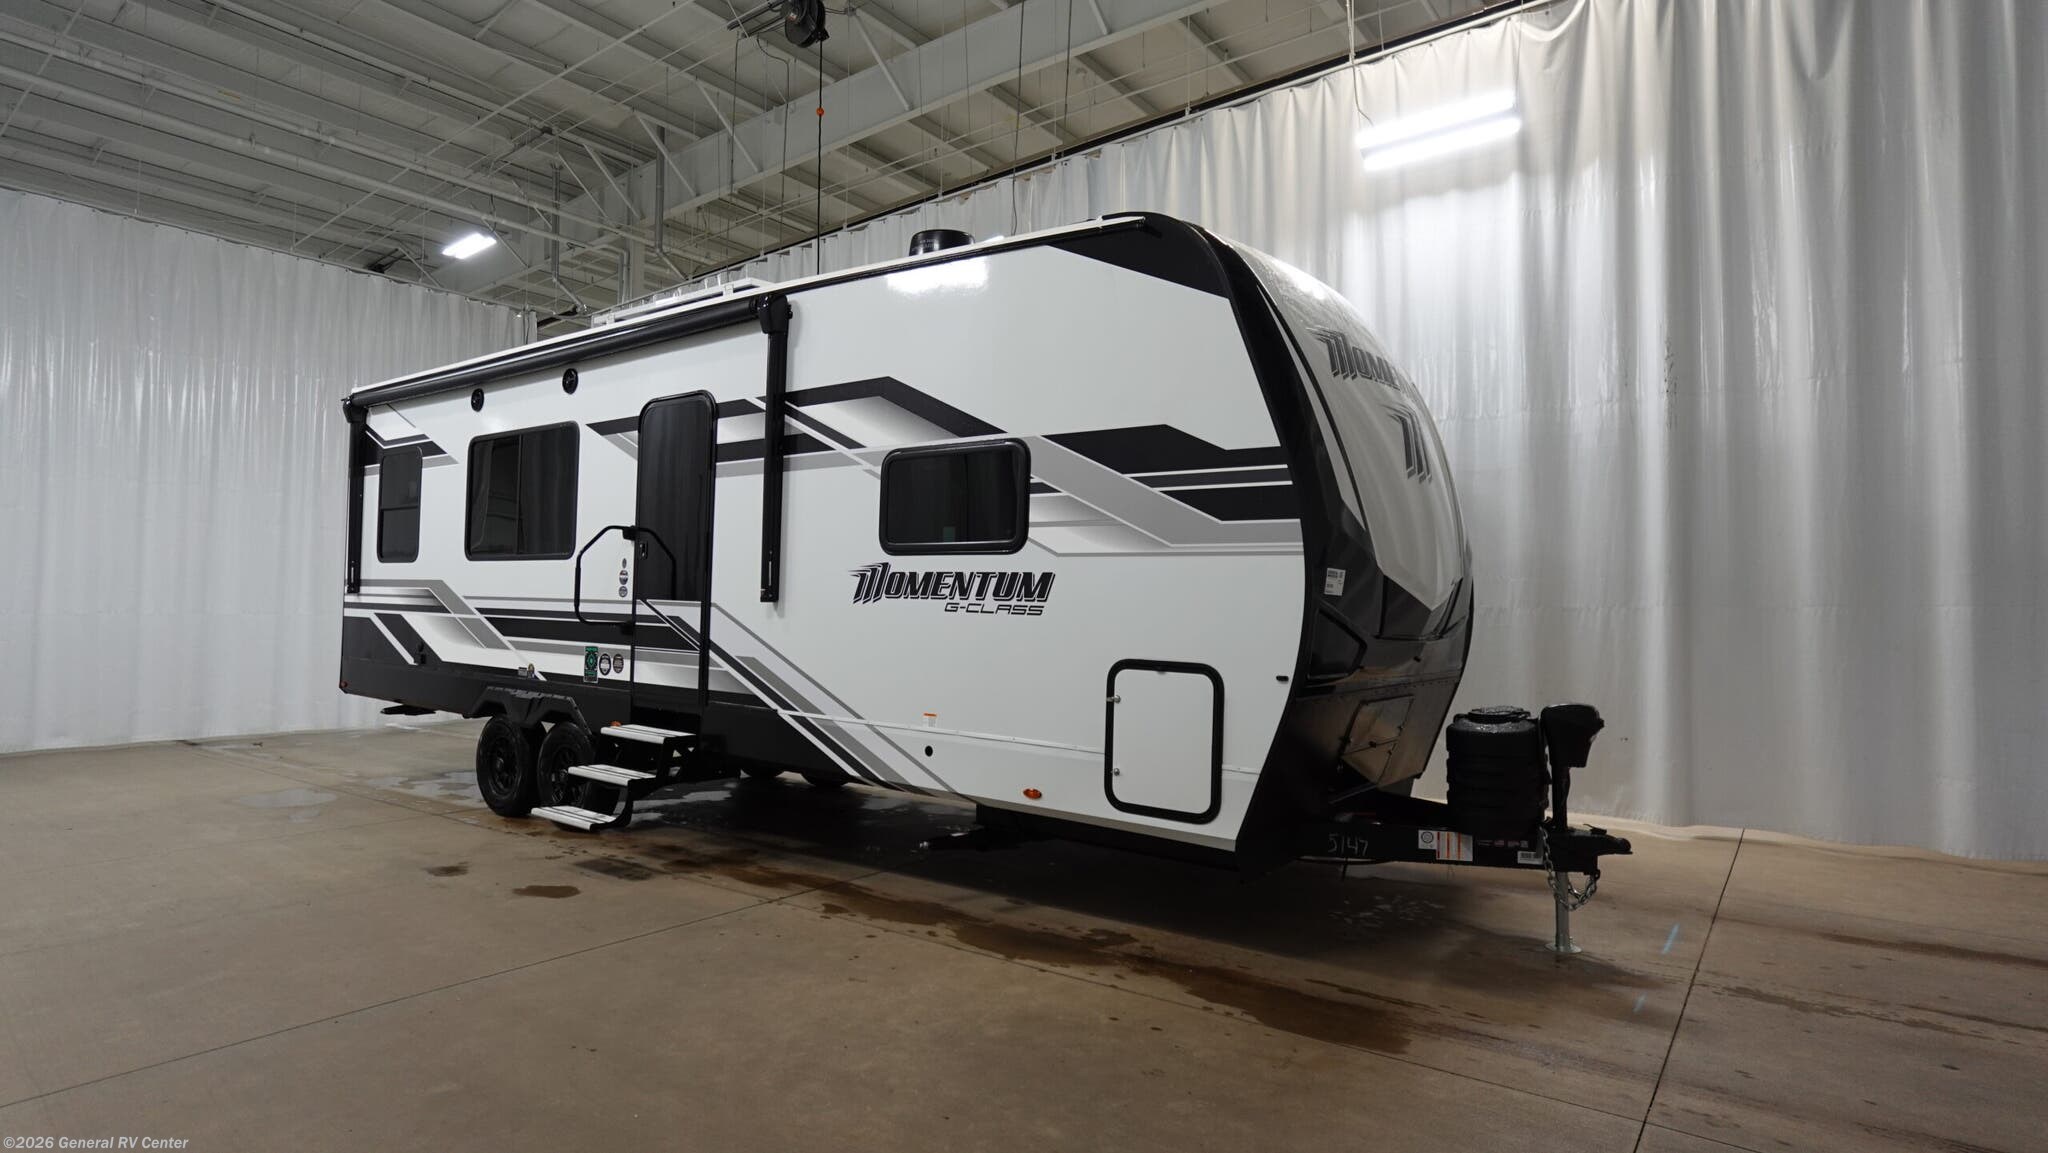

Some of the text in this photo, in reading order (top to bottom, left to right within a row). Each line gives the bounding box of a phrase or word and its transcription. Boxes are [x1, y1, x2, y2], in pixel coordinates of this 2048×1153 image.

[849, 562, 1056, 604] MOMENTUM
[944, 602, 1045, 616] G-CLASS
[1328, 833, 1368, 857] 5147
